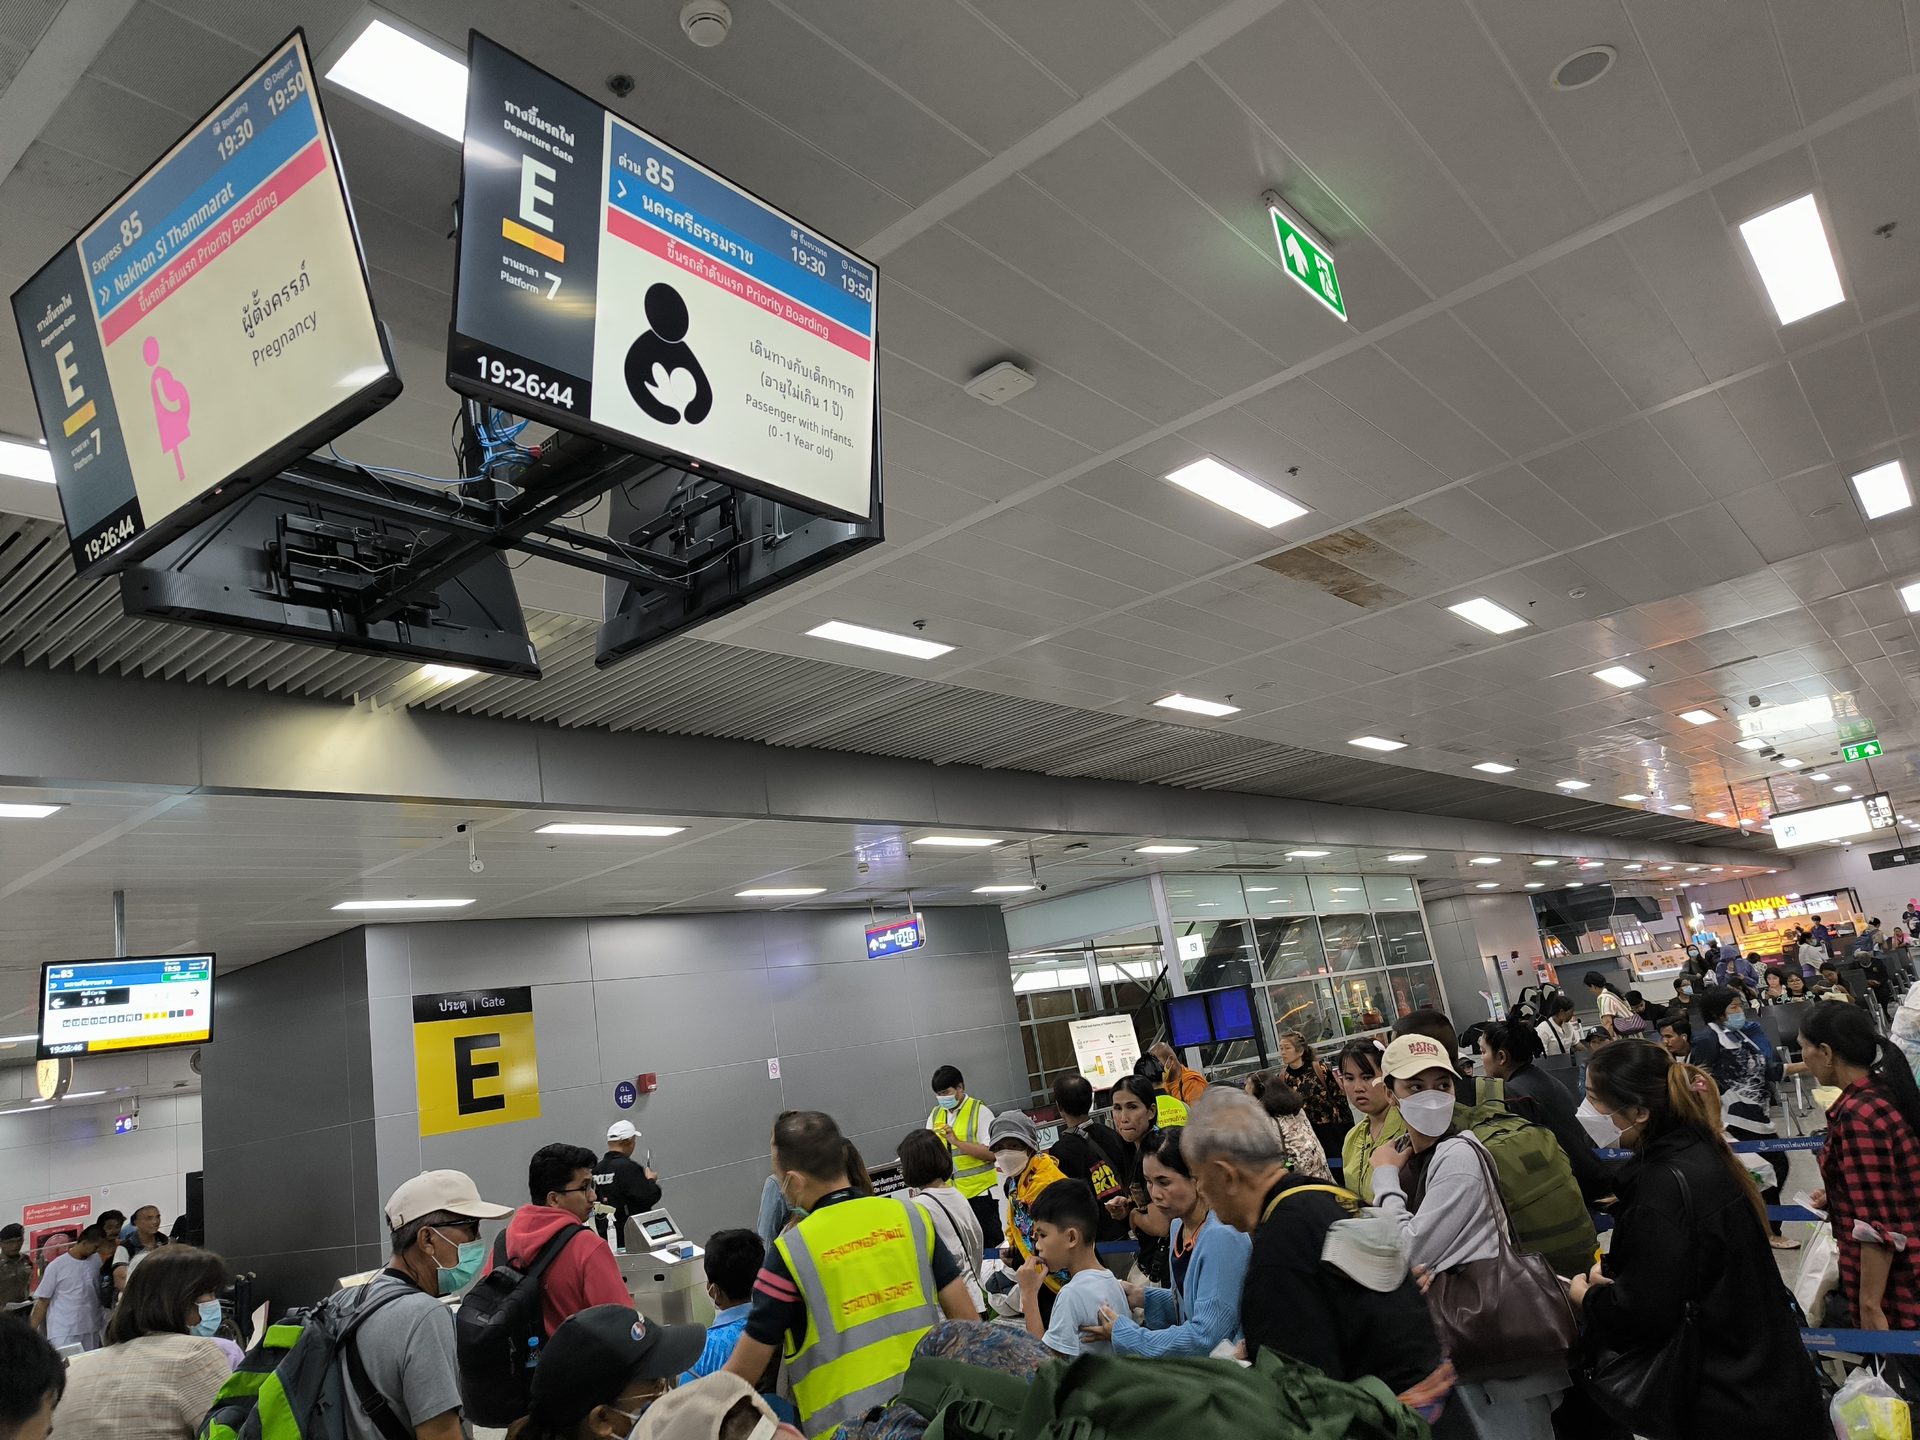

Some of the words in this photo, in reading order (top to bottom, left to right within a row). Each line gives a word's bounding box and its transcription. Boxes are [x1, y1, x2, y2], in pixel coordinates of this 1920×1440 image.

[268, 71, 305, 116] 19:50
[272, 60, 294, 84] Depart
[221, 102, 249, 129] Boarding
[504, 100, 575, 147] ทางขึ้นรถไฟ
[217, 118, 253, 161] 19:30
[503, 119, 551, 152] Departure
[552, 146, 574, 164] Gate
[519, 154, 556, 233] E
[618, 152, 642, 177] ด่วน
[645, 157, 675, 193] 85
[92, 242, 122, 275] Express
[120, 210, 143, 247] 85
[113, 251, 156, 296] Nakhon
[156, 236, 168, 260] Si
[166, 181, 235, 248] Thammarat
[138, 257, 198, 312] ขึ้นรถลำดับแรก
[198, 228, 232, 264] Priority
[231, 190, 279, 236] Boarding
[642, 194, 754, 266] นครศรีธรรมราช
[502, 255, 539, 279] ชานชาลา
[791, 246, 826, 277] 19:30
[242, 259, 311, 339] ผู้ตั้งครรภ์
[500, 270, 539, 295] Platform
[544, 271, 562, 301] 7
[667, 239, 744, 294] ขึ้นรถลำดับแรก
[746, 284, 784, 317] Priority
[785, 305, 829, 340] Boarding
[841, 274, 872, 303] 19:50
[252, 310, 317, 367] Pregnancy
[54, 341, 85, 408] E
[476, 355, 575, 410] 19:26:44
[750, 339, 854, 399] เดินทางกับเด็กทารก
[760, 371, 820, 409] (อายุไม่เกิน
[823, 399, 828, 412] 1
[831, 400, 844, 421] ปี)
[90, 427, 101, 456] 7
[745, 393, 797, 424] Passenger
[798, 418, 819, 434] with
[821, 425, 854, 448] infants.
[768, 424, 778, 438] (0
[786, 431, 791, 443] 1
[793, 434, 814, 452] Year
[816, 445, 834, 461] old)
[84, 514, 135, 563] 19:26:44
[1728, 895, 1788, 915] DUNKIN
[94, 996, 106, 1005] 14
[438, 998, 468, 1014] ประตู
[481, 996, 506, 1009] Gate
[454, 1033, 506, 1115] E
[618, 1094, 633, 1104] 15E
[881, 1182, 897, 1193] Luggage
[842, 1291, 882, 1316] STATION
[883, 1281, 914, 1302] STAFF
